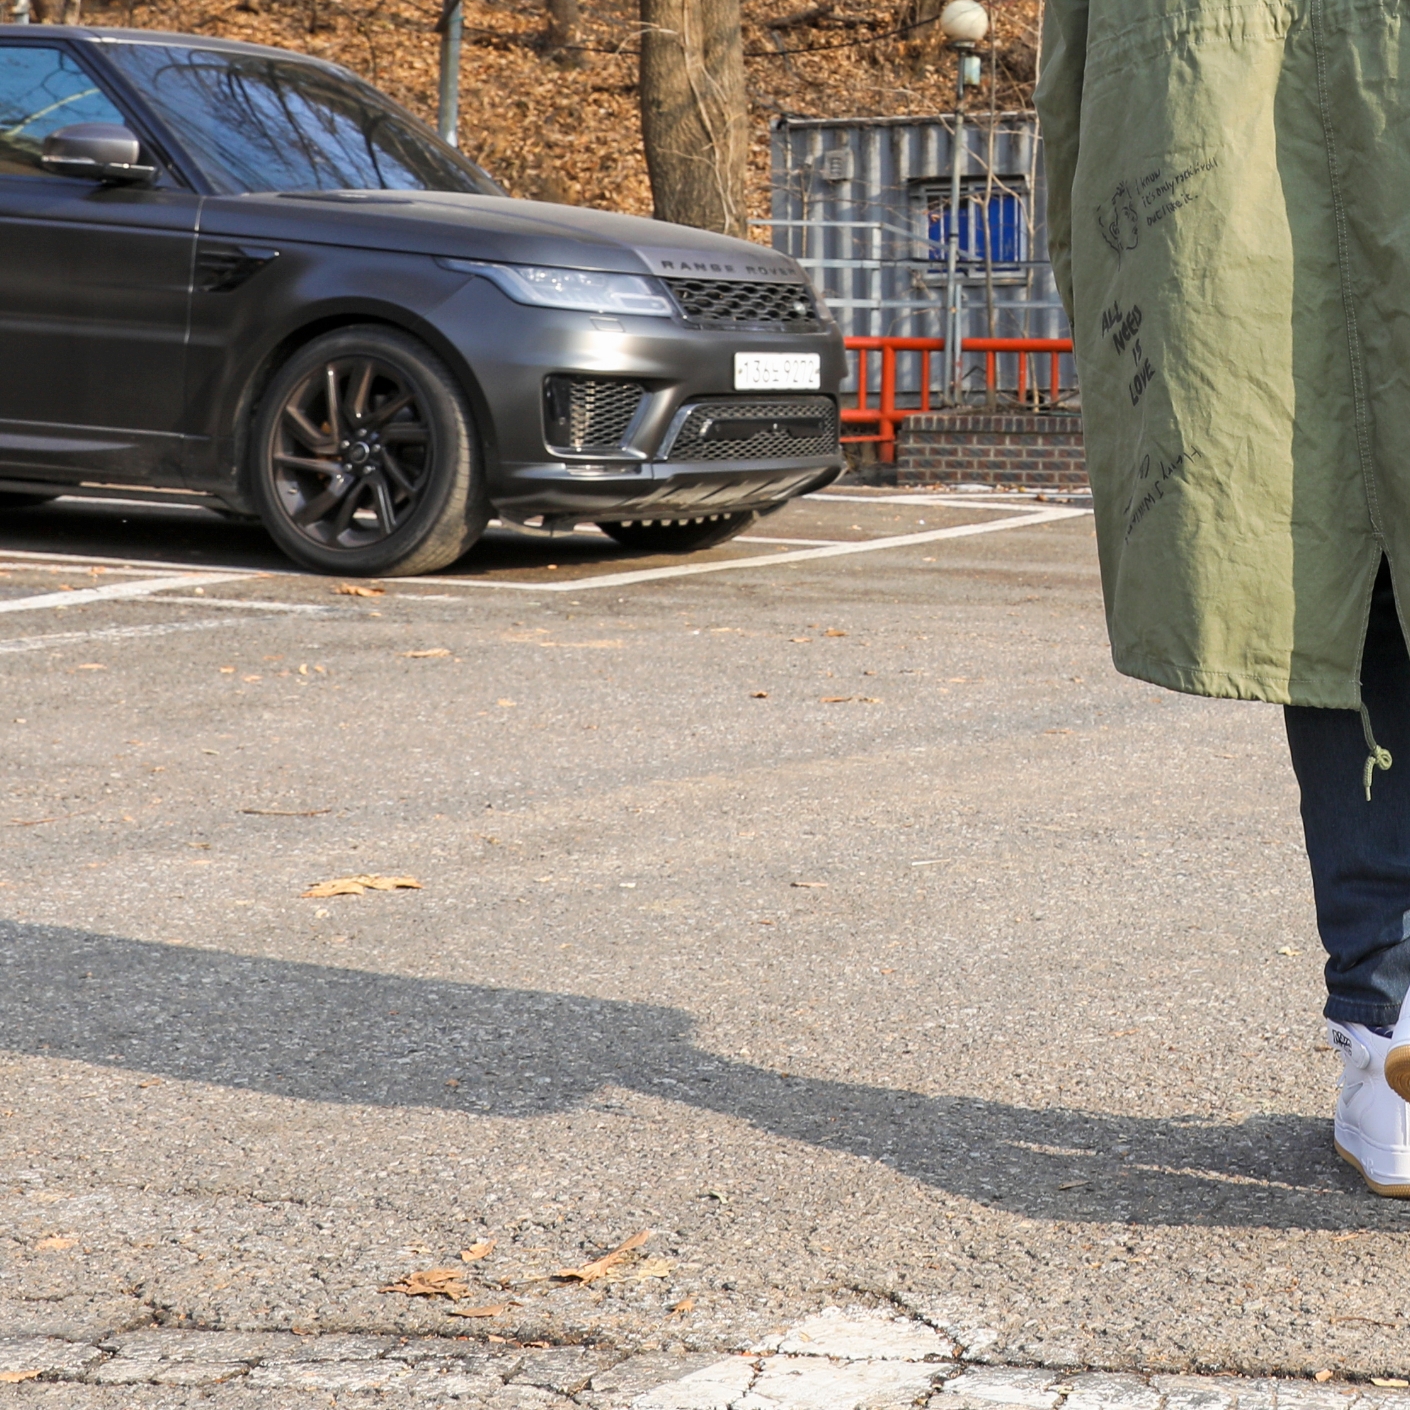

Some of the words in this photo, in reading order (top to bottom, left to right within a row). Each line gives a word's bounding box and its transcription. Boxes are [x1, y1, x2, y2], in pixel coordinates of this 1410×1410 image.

[660, 260, 736, 274] RANGE
[744, 265, 798, 277] ROVER
[1101, 300, 1123, 340] ALL
[1132, 337, 1143, 368] IS
[783, 359, 815, 383] 9272
[1128, 357, 1156, 407] LOVE
